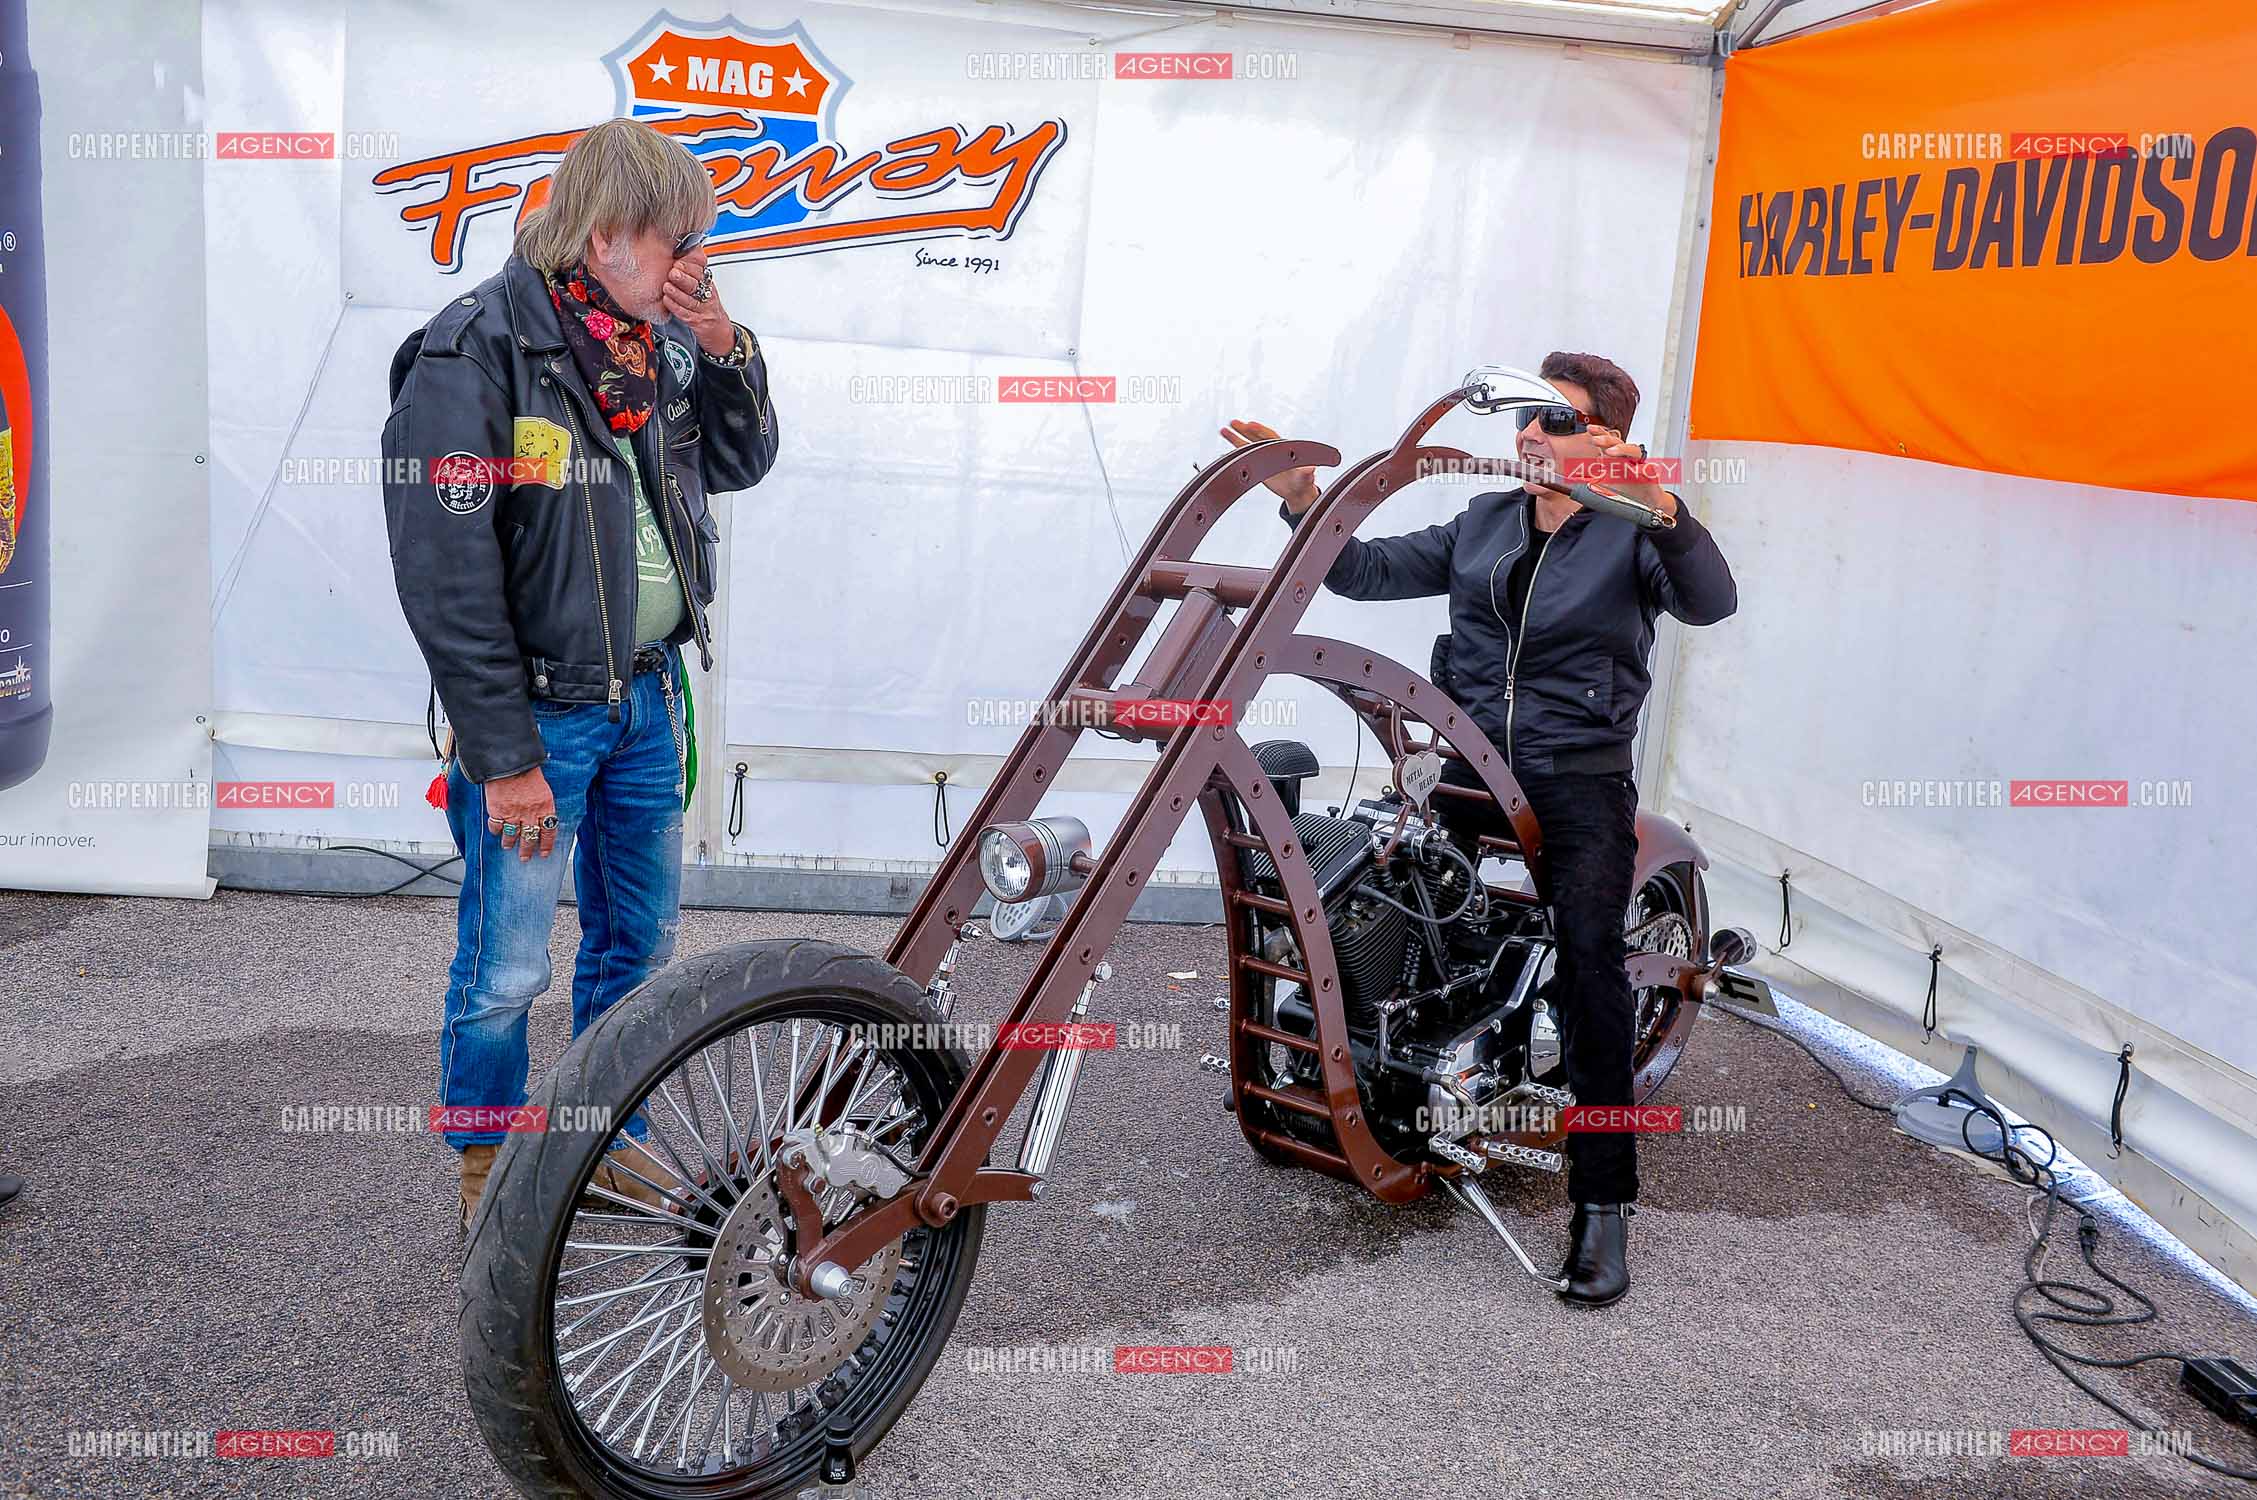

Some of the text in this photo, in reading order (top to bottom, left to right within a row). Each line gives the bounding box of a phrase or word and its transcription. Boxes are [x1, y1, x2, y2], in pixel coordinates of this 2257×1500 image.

[686, 56, 774, 98] MAG
[372, 109, 1067, 275] Feway
[1739, 126, 2257, 279] HARLEY-DAVIDSO
[915, 247, 1000, 275] Since 1991
[1406, 767, 1424, 786] METAL
[1418, 773, 1437, 792] HEART
[31, 832, 96, 848] innover.
